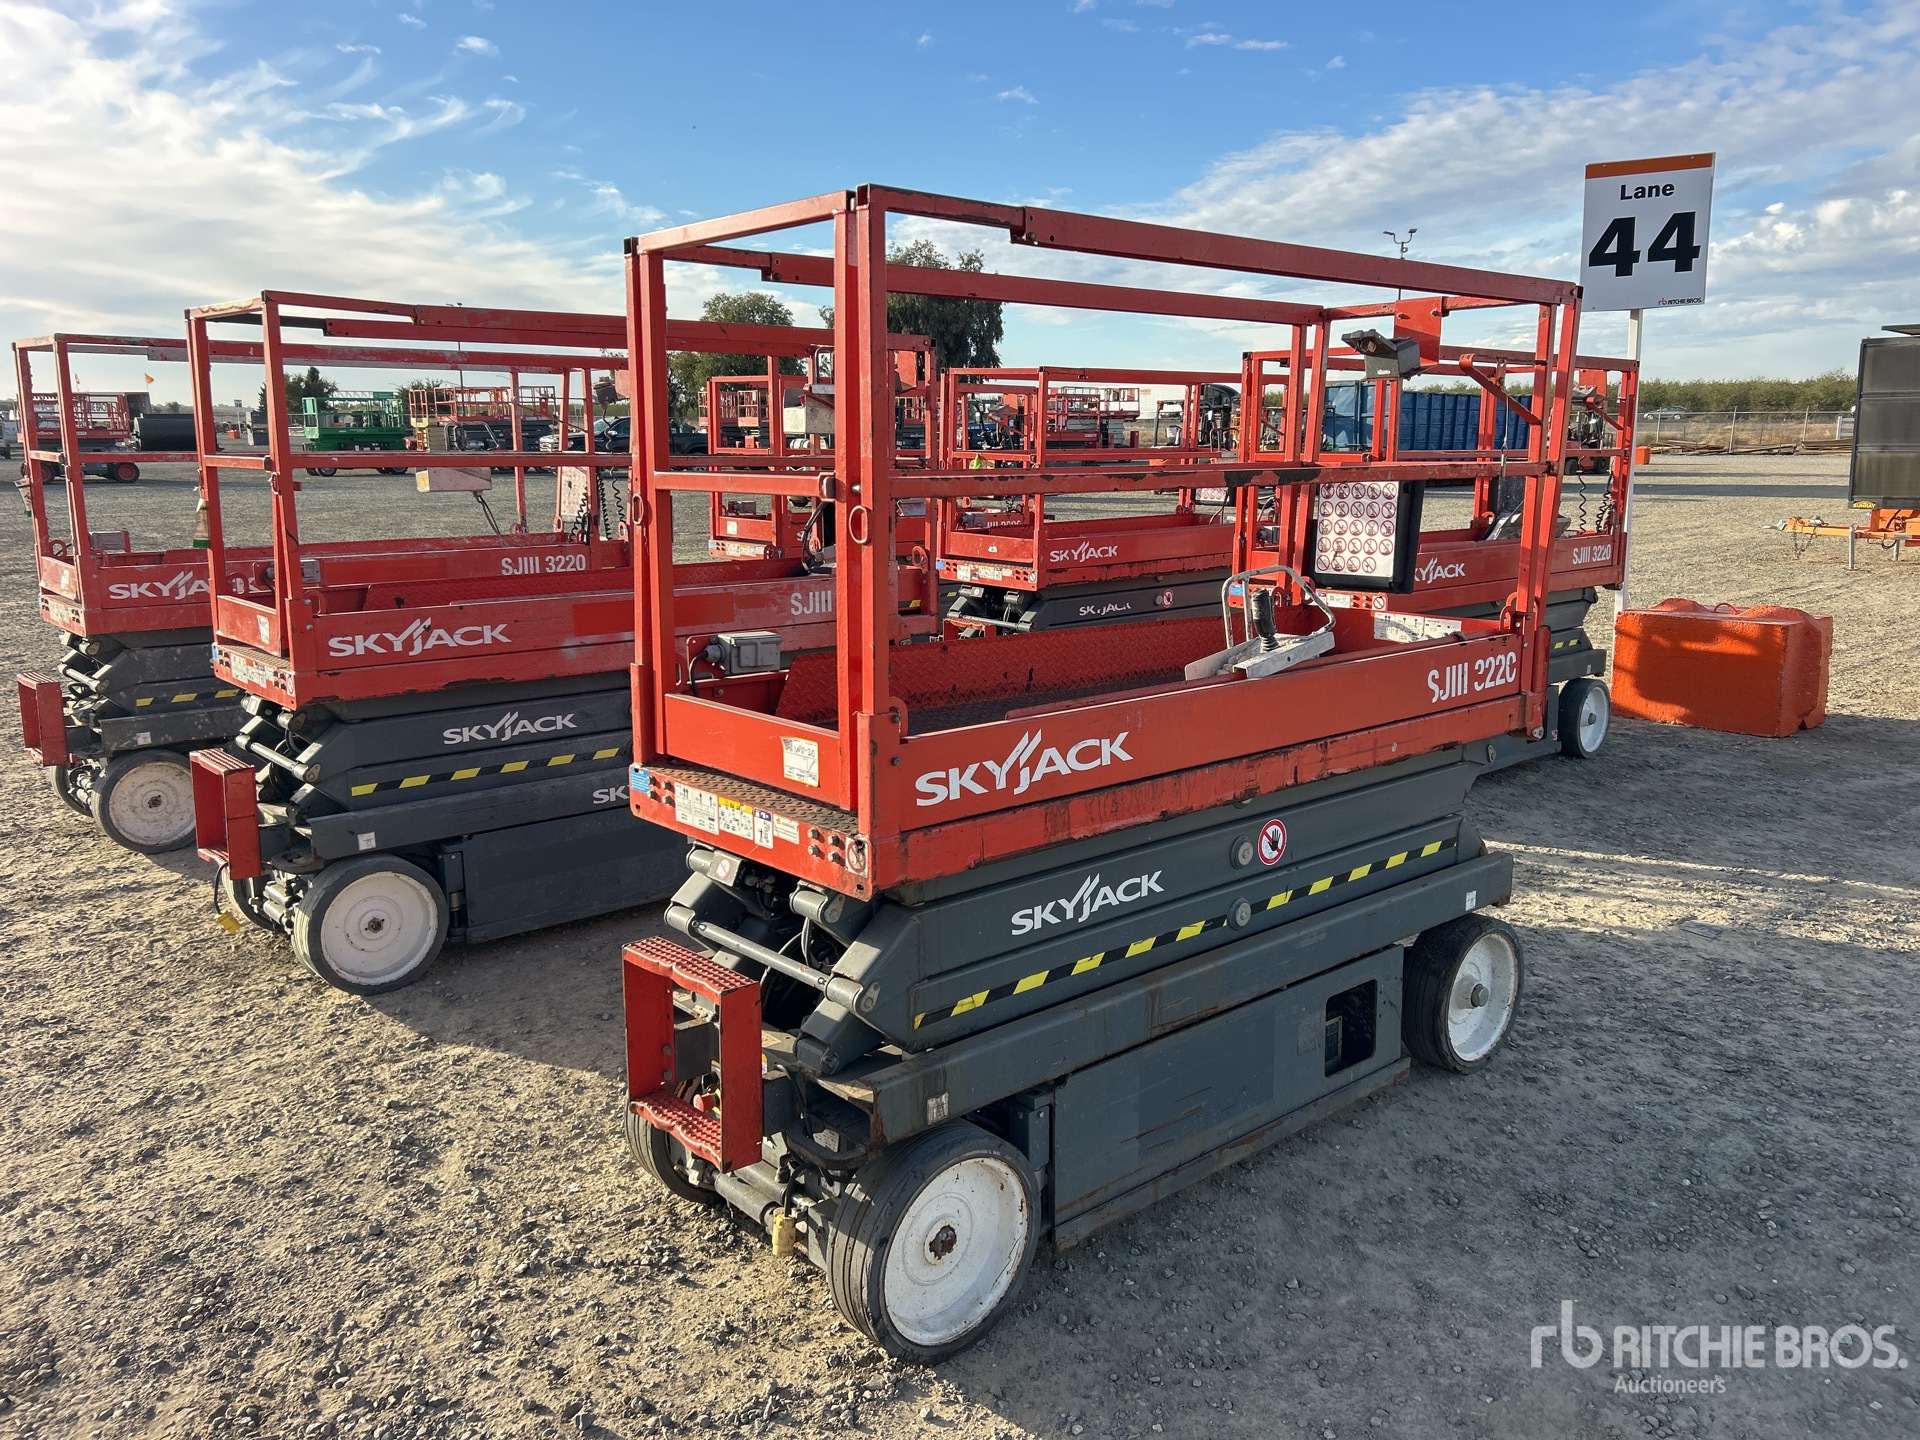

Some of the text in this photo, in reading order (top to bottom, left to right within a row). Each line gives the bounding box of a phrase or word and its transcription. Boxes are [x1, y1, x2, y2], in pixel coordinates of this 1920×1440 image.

[1620, 183, 1675, 200] Lane
[1588, 211, 1702, 277] 44
[501, 554, 587, 576] SJIII 3220
[1049, 541, 1119, 563] SKYJACK
[1572, 544, 1612, 565] SJIII 3220
[790, 590, 833, 616] SJIII
[328, 617, 513, 657] SKYJACK
[1427, 661, 1469, 704] SJIII
[443, 710, 578, 745] SKYJACK
[914, 728, 1134, 807] SKYJACK
[1011, 870, 1165, 936] SKYJACK
